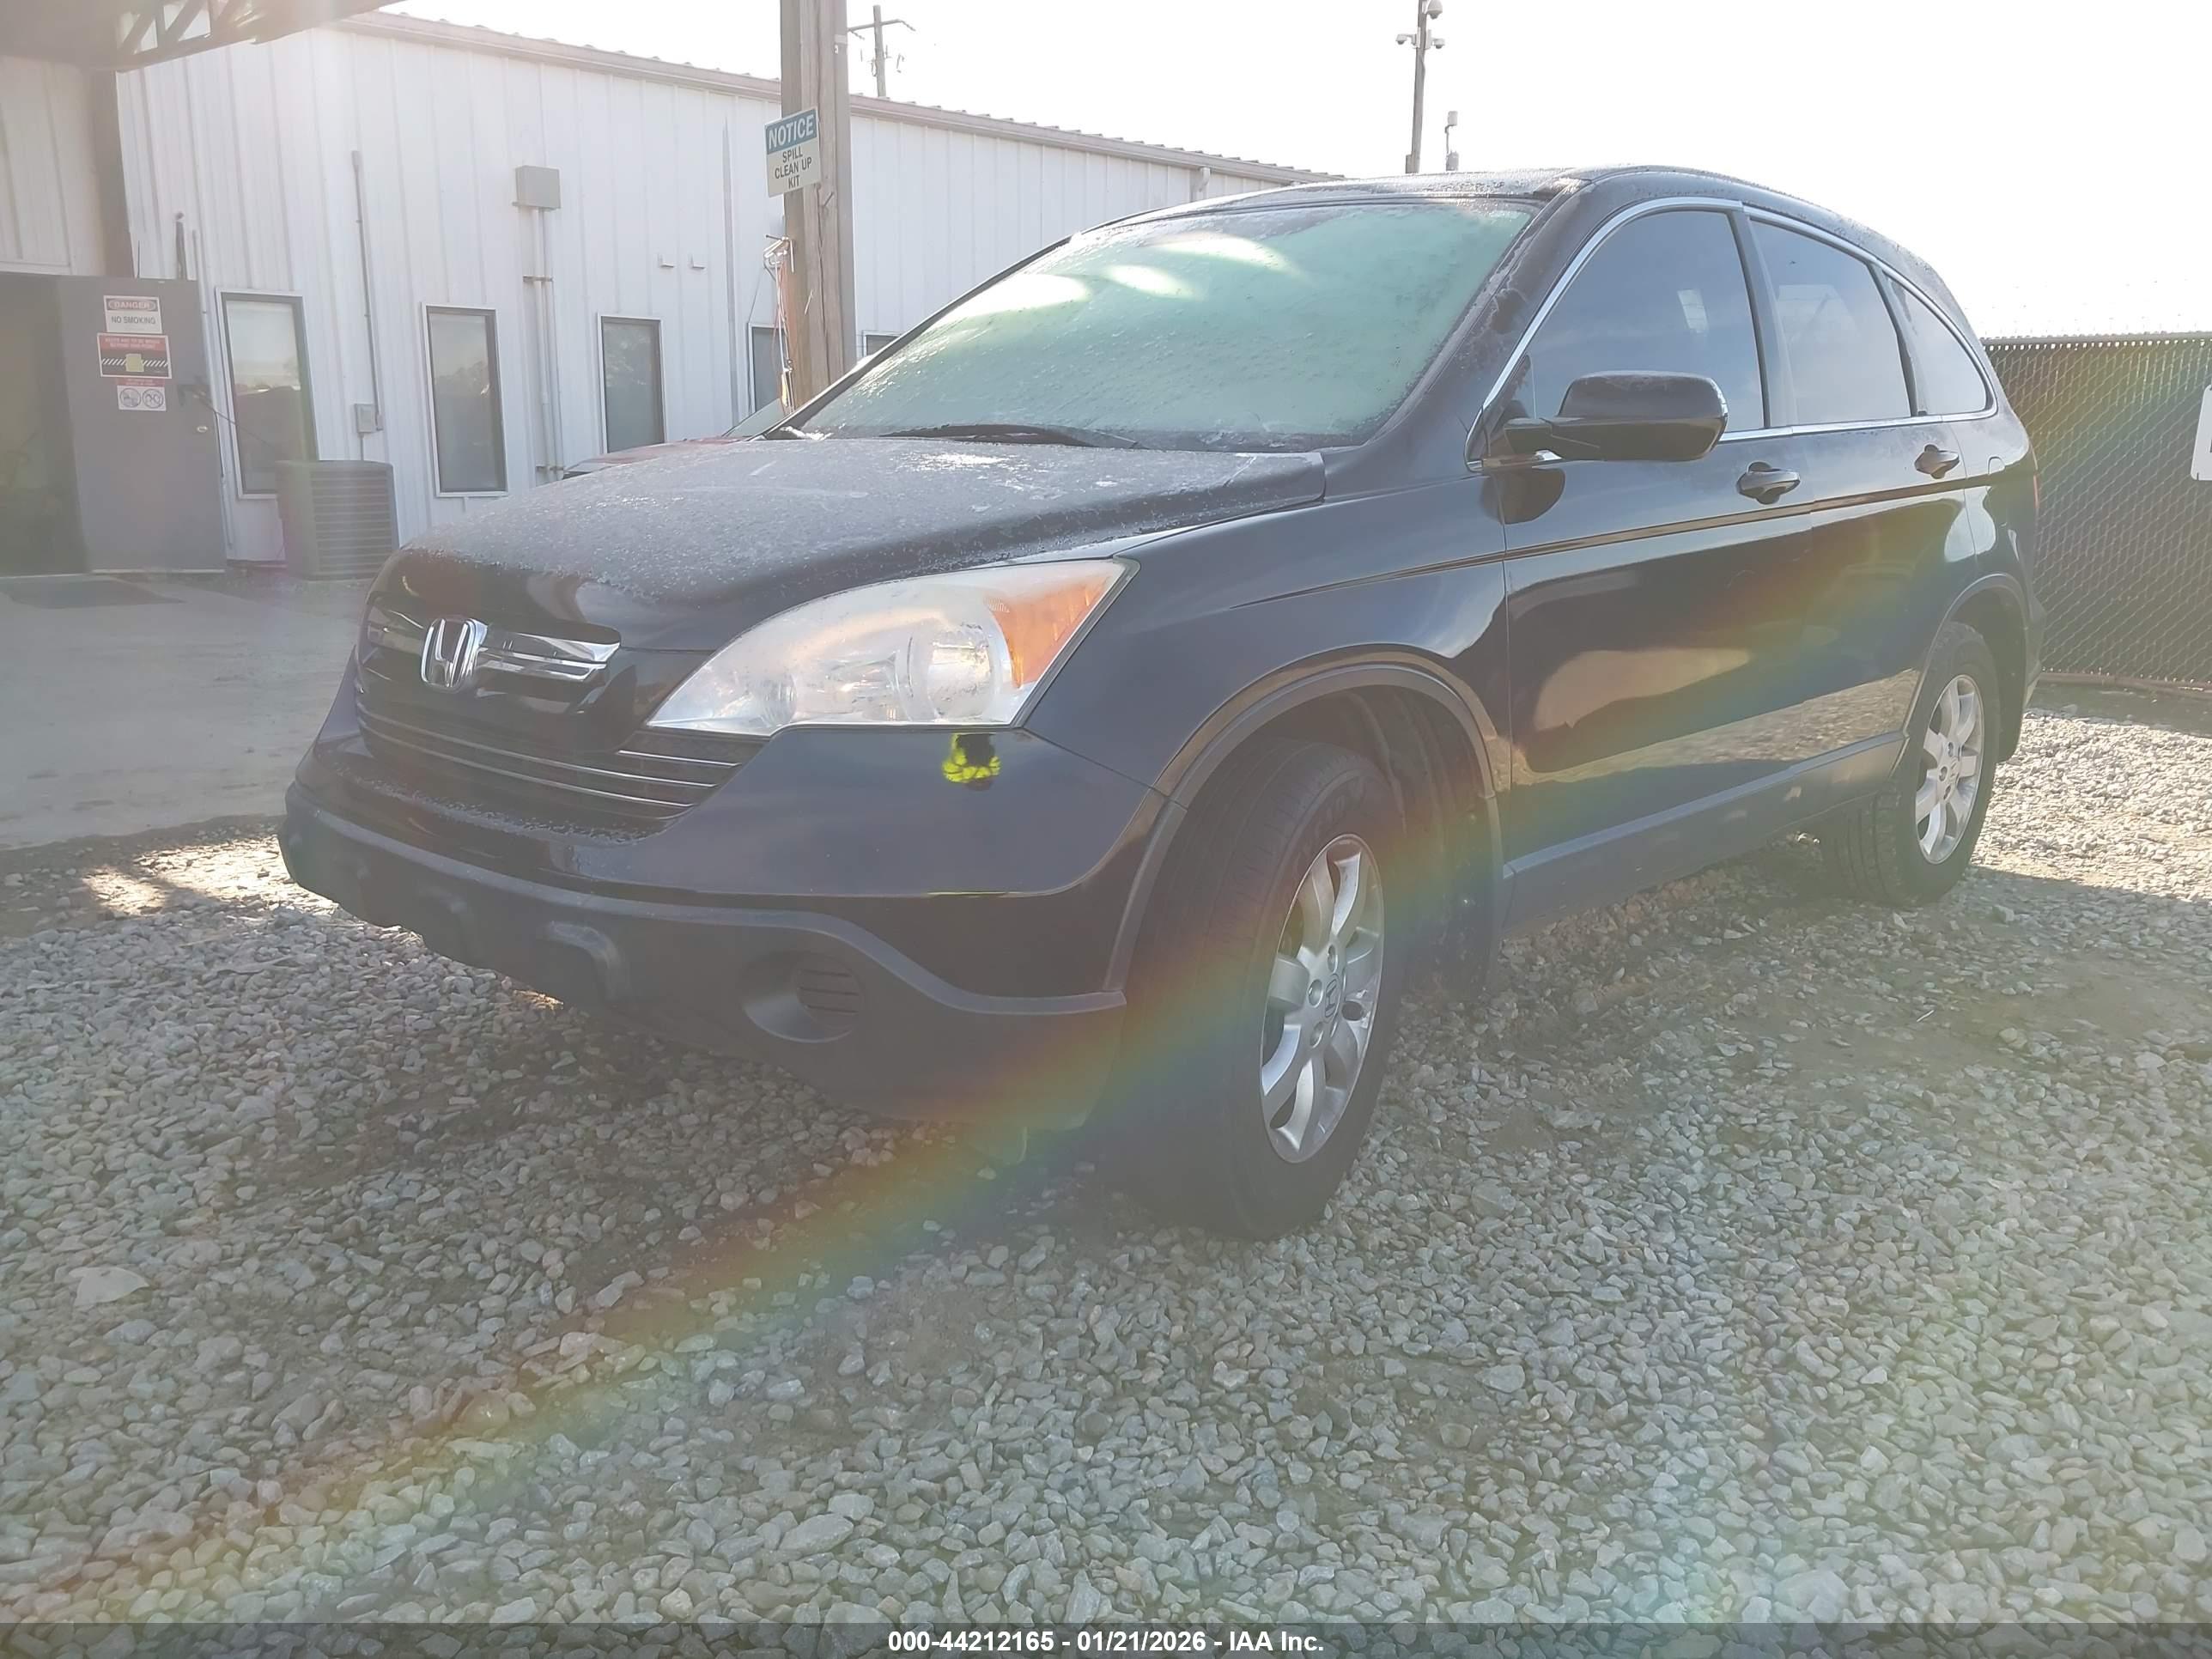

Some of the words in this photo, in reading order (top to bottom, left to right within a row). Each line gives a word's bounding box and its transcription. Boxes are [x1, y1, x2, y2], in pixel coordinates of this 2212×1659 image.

[769, 114, 815, 149] NOTICE
[782, 145, 803, 163] SPILL
[775, 161, 799, 179] CLEAN
[801, 156, 812, 171] UP
[788, 174, 800, 190] KIT
[113, 301, 151, 310] DANGER
[123, 316, 156, 325] SMOKING
